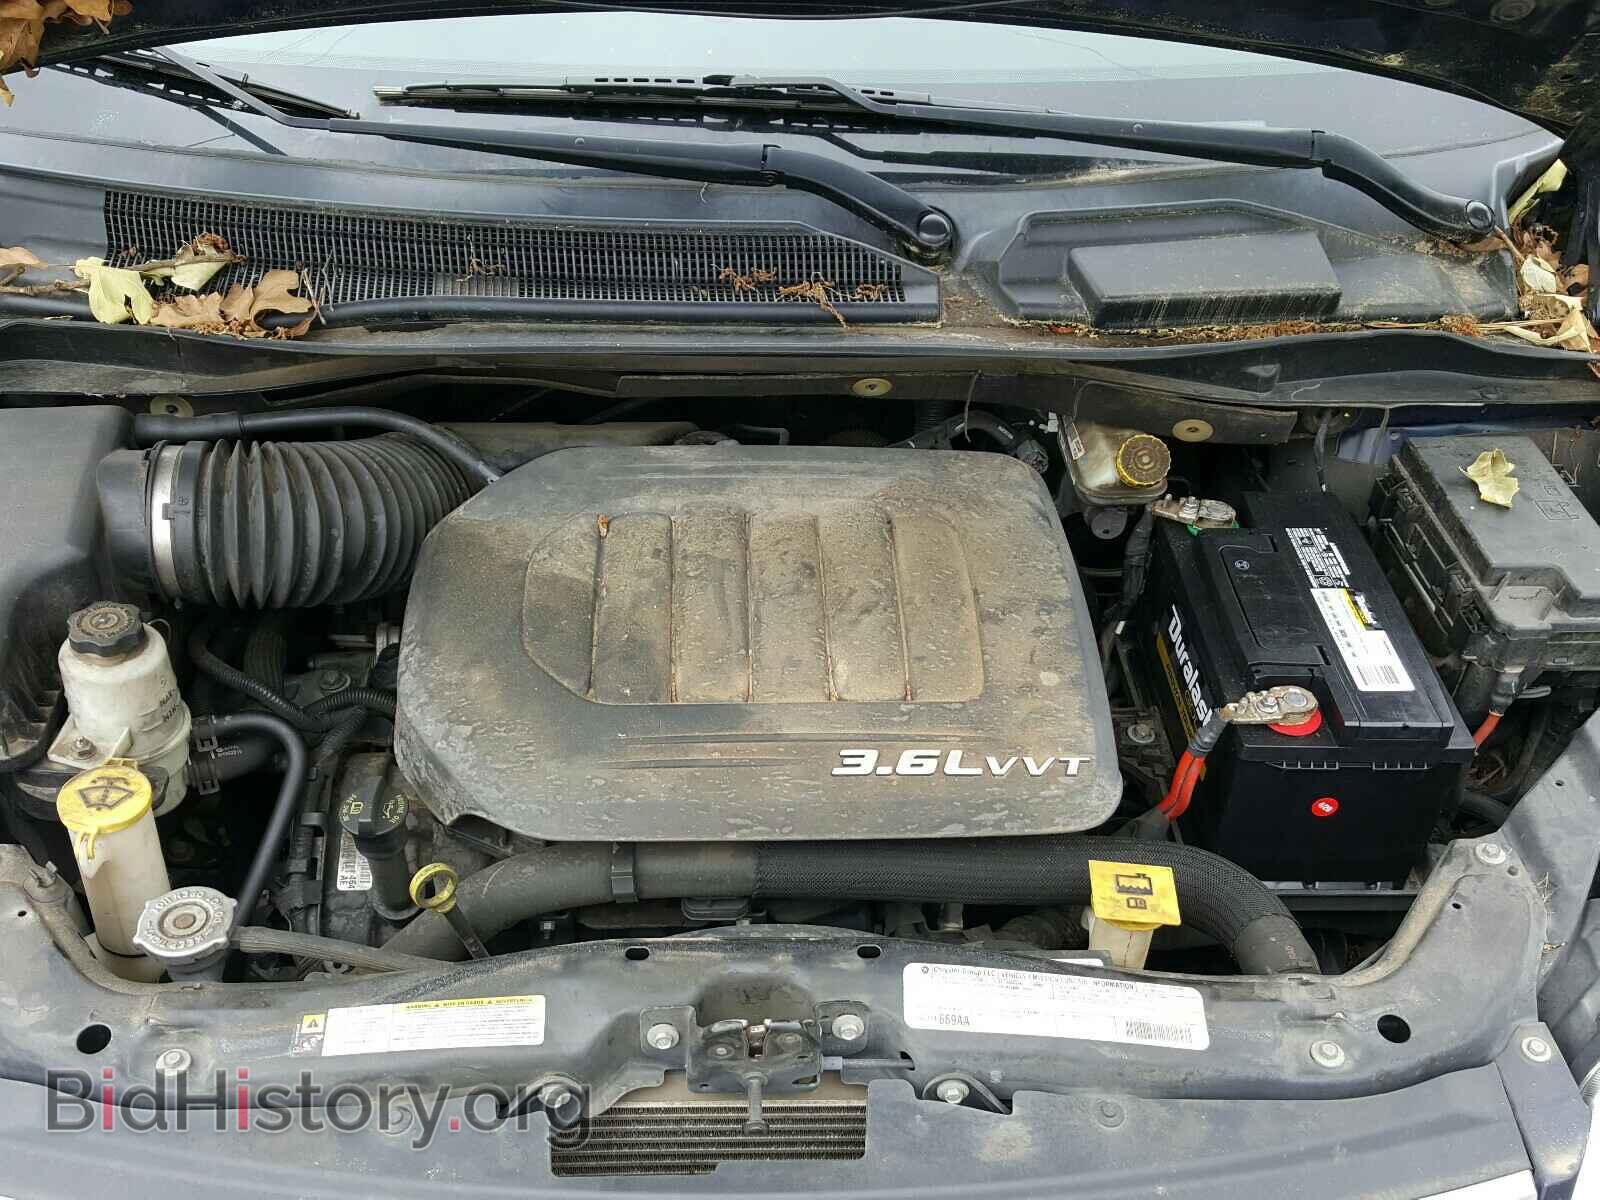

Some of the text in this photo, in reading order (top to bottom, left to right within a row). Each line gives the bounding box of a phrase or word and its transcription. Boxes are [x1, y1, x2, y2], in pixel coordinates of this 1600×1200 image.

[1168, 604, 1213, 727] Duralast
[831, 749, 1091, 777] 3.6L VVT
